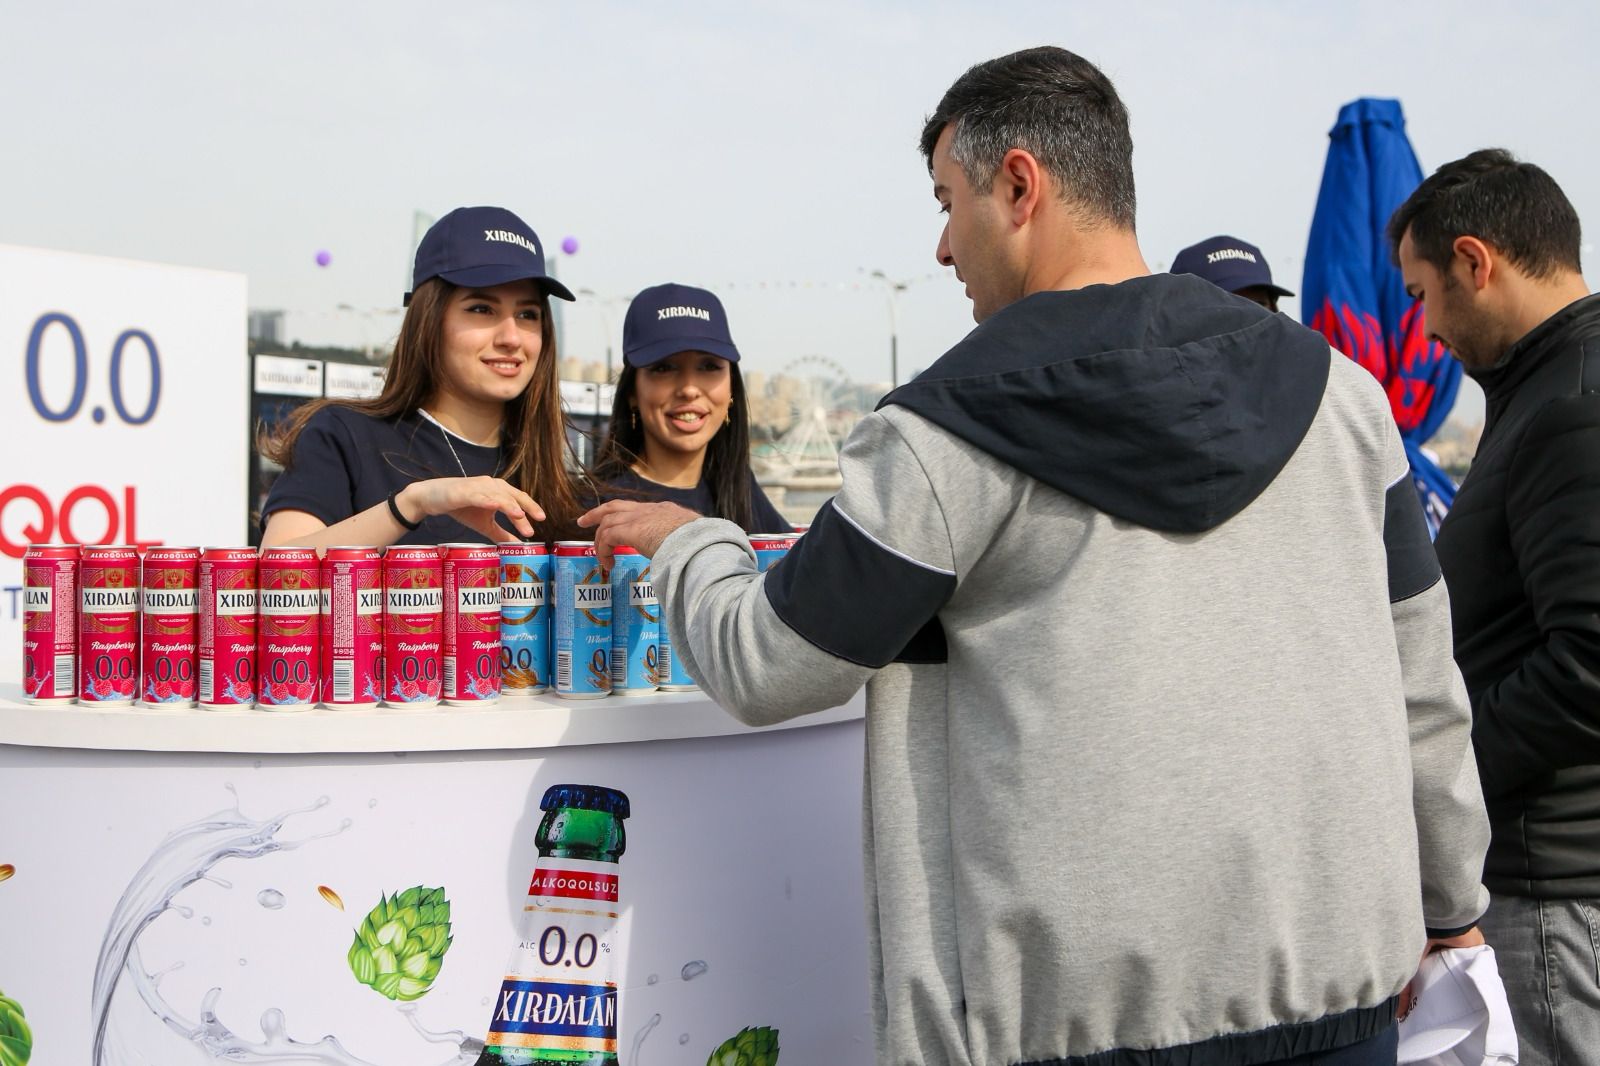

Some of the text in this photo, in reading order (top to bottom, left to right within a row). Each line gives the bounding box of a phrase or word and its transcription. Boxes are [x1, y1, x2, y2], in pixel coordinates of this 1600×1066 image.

[484, 228, 537, 255] XIRDALAN
[1206, 248, 1257, 264] XIRDALAN
[657, 306, 711, 323] XIRDALAN
[25, 311, 163, 425] 0.0
[90, 551, 137, 560] ALKOQOLSUZ
[151, 552, 197, 560] ALKOQOLSUZ
[262, 592, 319, 608] XIRDALAN
[633, 586, 657, 599] XIR
[91, 641, 137, 654] Raspberry
[152, 642, 196, 655] Raspberry
[267, 643, 313, 656] Raspberry
[398, 641, 440, 655] Raspberry
[94, 654, 133, 681] 0.0
[155, 655, 193, 683] 0.0
[271, 658, 310, 684] 0.0
[402, 655, 437, 682] 0.0
[531, 875, 617, 895] ALKOQOLSUZ
[518, 941, 537, 951] ALC
[538, 924, 599, 969] 0.0
[495, 988, 615, 1028] XIRDALAN
